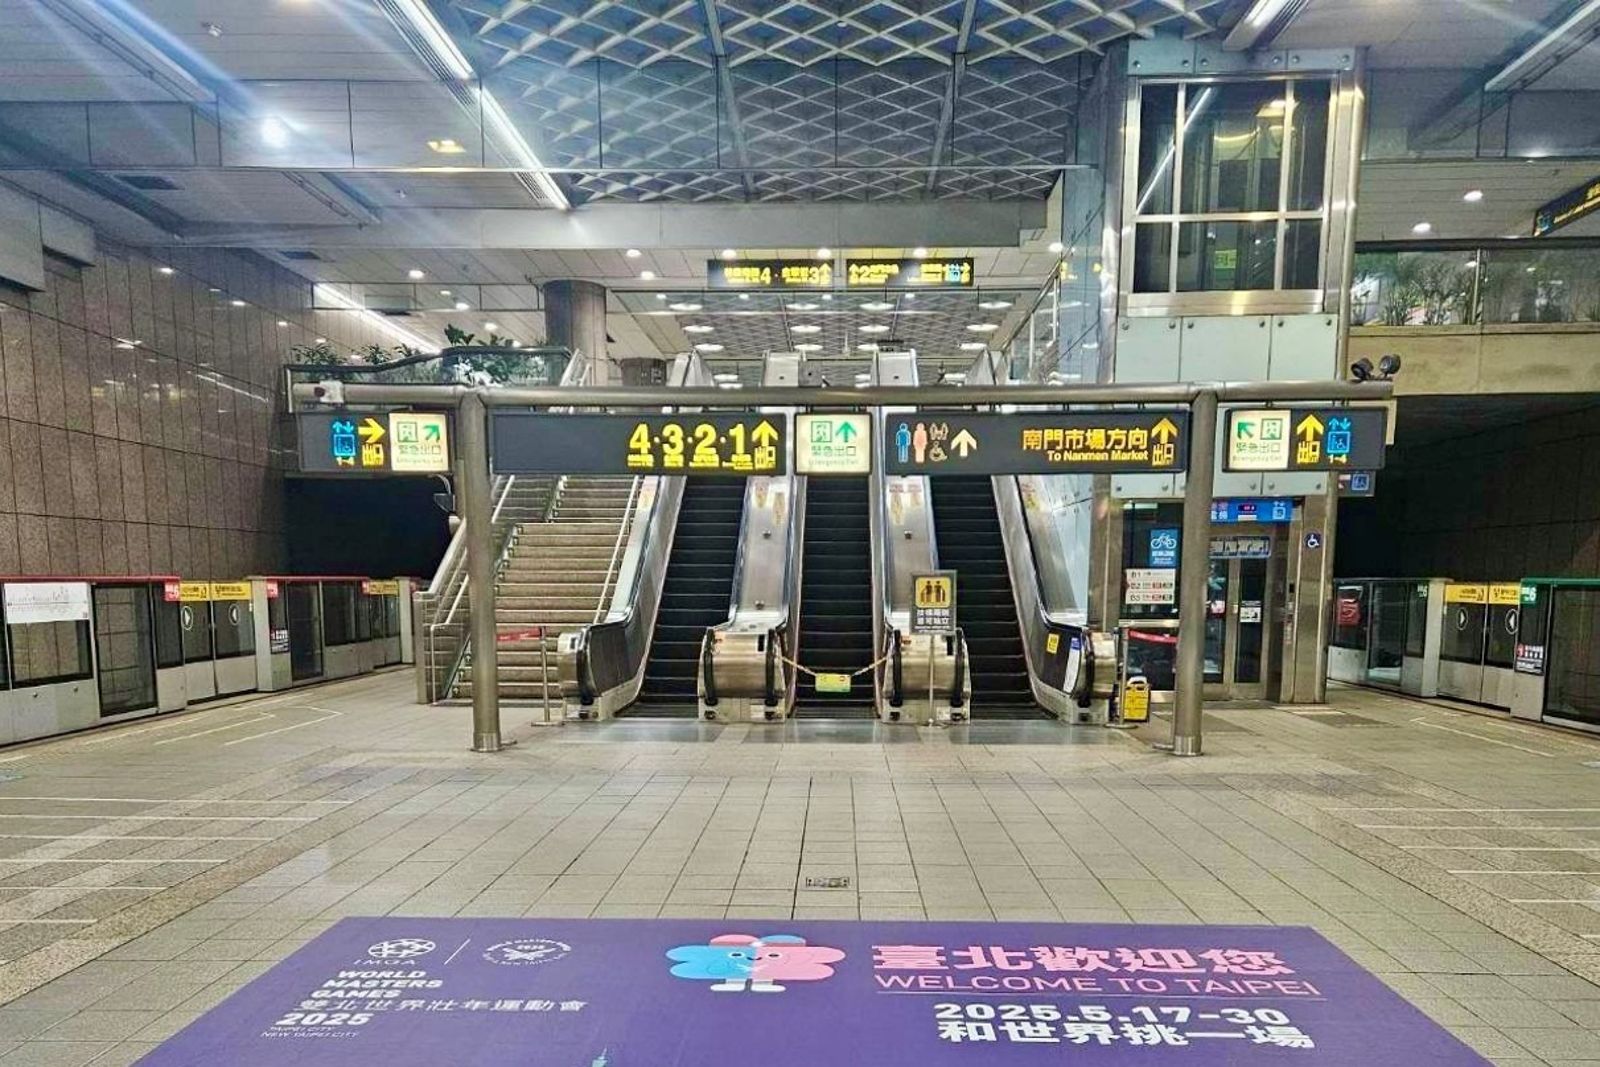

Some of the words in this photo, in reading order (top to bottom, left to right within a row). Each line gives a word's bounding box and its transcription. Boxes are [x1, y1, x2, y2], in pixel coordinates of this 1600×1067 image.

[1023, 428, 1148, 450] 南門市場方向
[1047, 450, 1062, 461] To
[1063, 450, 1109, 461] Nanmen
[1111, 450, 1148, 460] Market
[871, 945, 1295, 976] 臺北歡迎您
[337, 970, 427, 978] WORLD
[321, 979, 444, 988] MASTERS
[874, 974, 1103, 991] WELCOME
[1107, 978, 1167, 993] TO
[1174, 979, 1321, 995] TAIPEI
[310, 989, 402, 998] GAMES
[274, 1012, 375, 1026] 2025
[934, 1003, 1290, 1025] 2025.5.17-30
[937, 1020, 1315, 1048] 和世界挑一場
